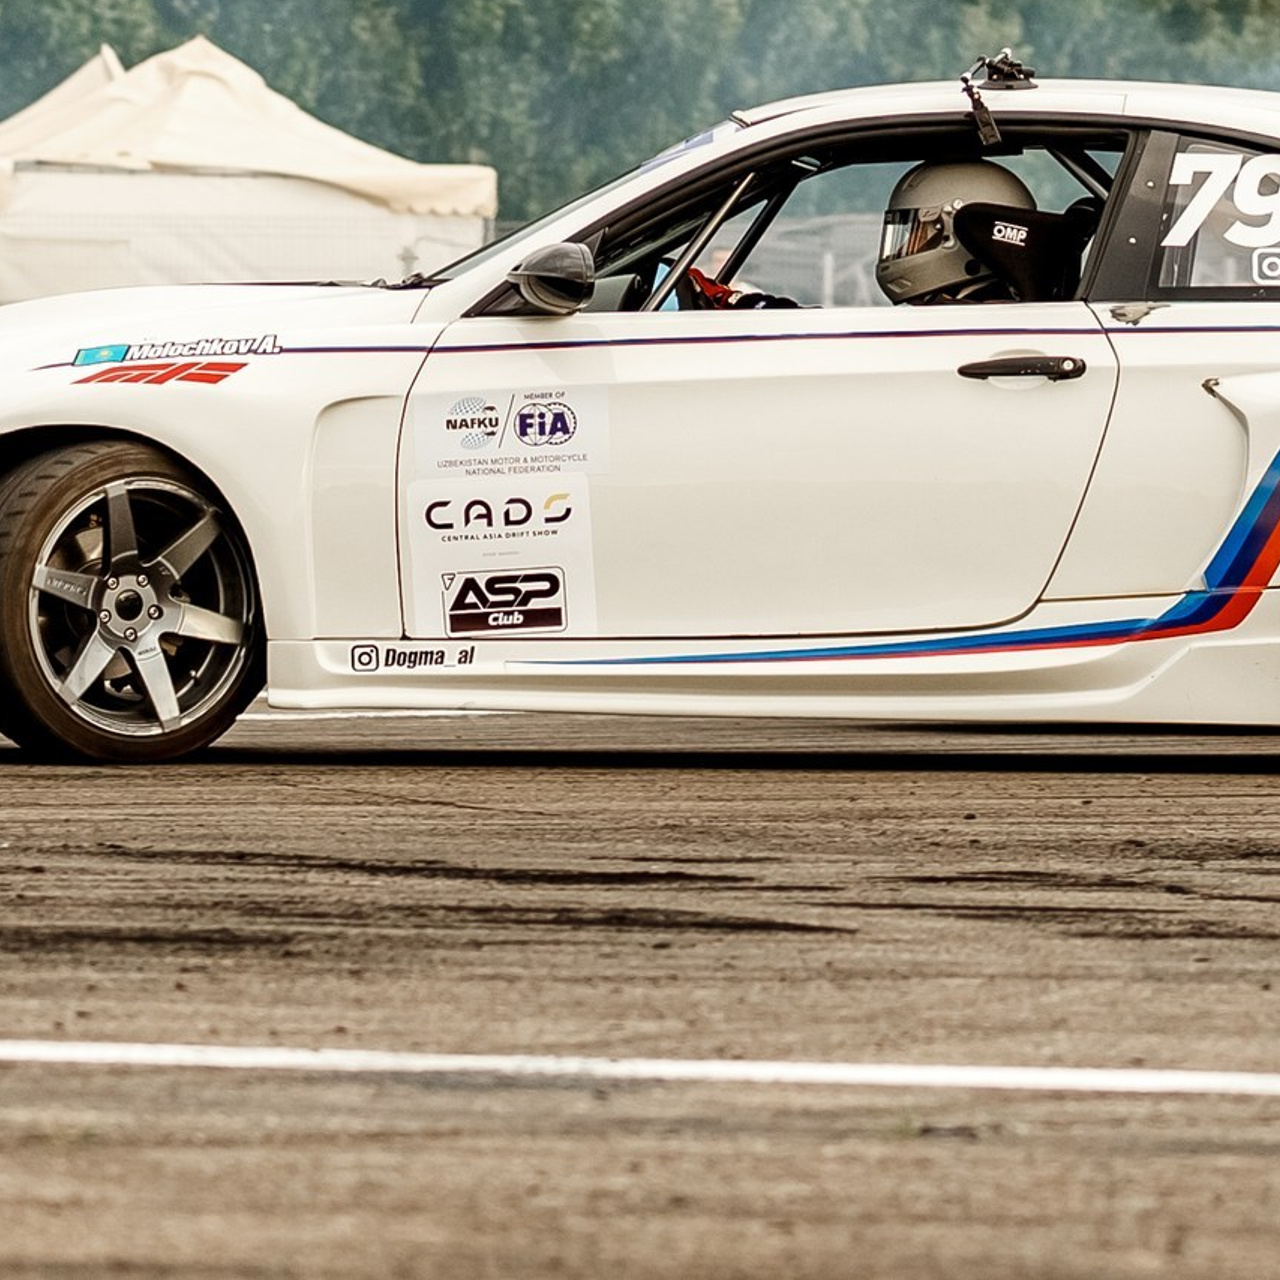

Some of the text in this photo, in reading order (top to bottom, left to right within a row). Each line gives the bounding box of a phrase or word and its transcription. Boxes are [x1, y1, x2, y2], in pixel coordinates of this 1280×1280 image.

[992, 224, 1028, 243] OMP
[125, 334, 283, 361] Molochkov A.
[523, 391, 566, 401] MEMBER OF
[445, 416, 500, 431] NAFKU
[437, 452, 588, 469] UZBEKISTAN MOTOR & MOTORCYCLE
[465, 464, 561, 476] NATIONAL FEDERATION
[424, 493, 573, 530] CADS
[441, 535, 481, 543] CENTRAL
[505, 531, 531, 539] DRIFT
[532, 529, 559, 537] SHOW
[449, 572, 561, 612] ASP
[487, 611, 525, 627] Club
[383, 645, 476, 670] Dogma_al
